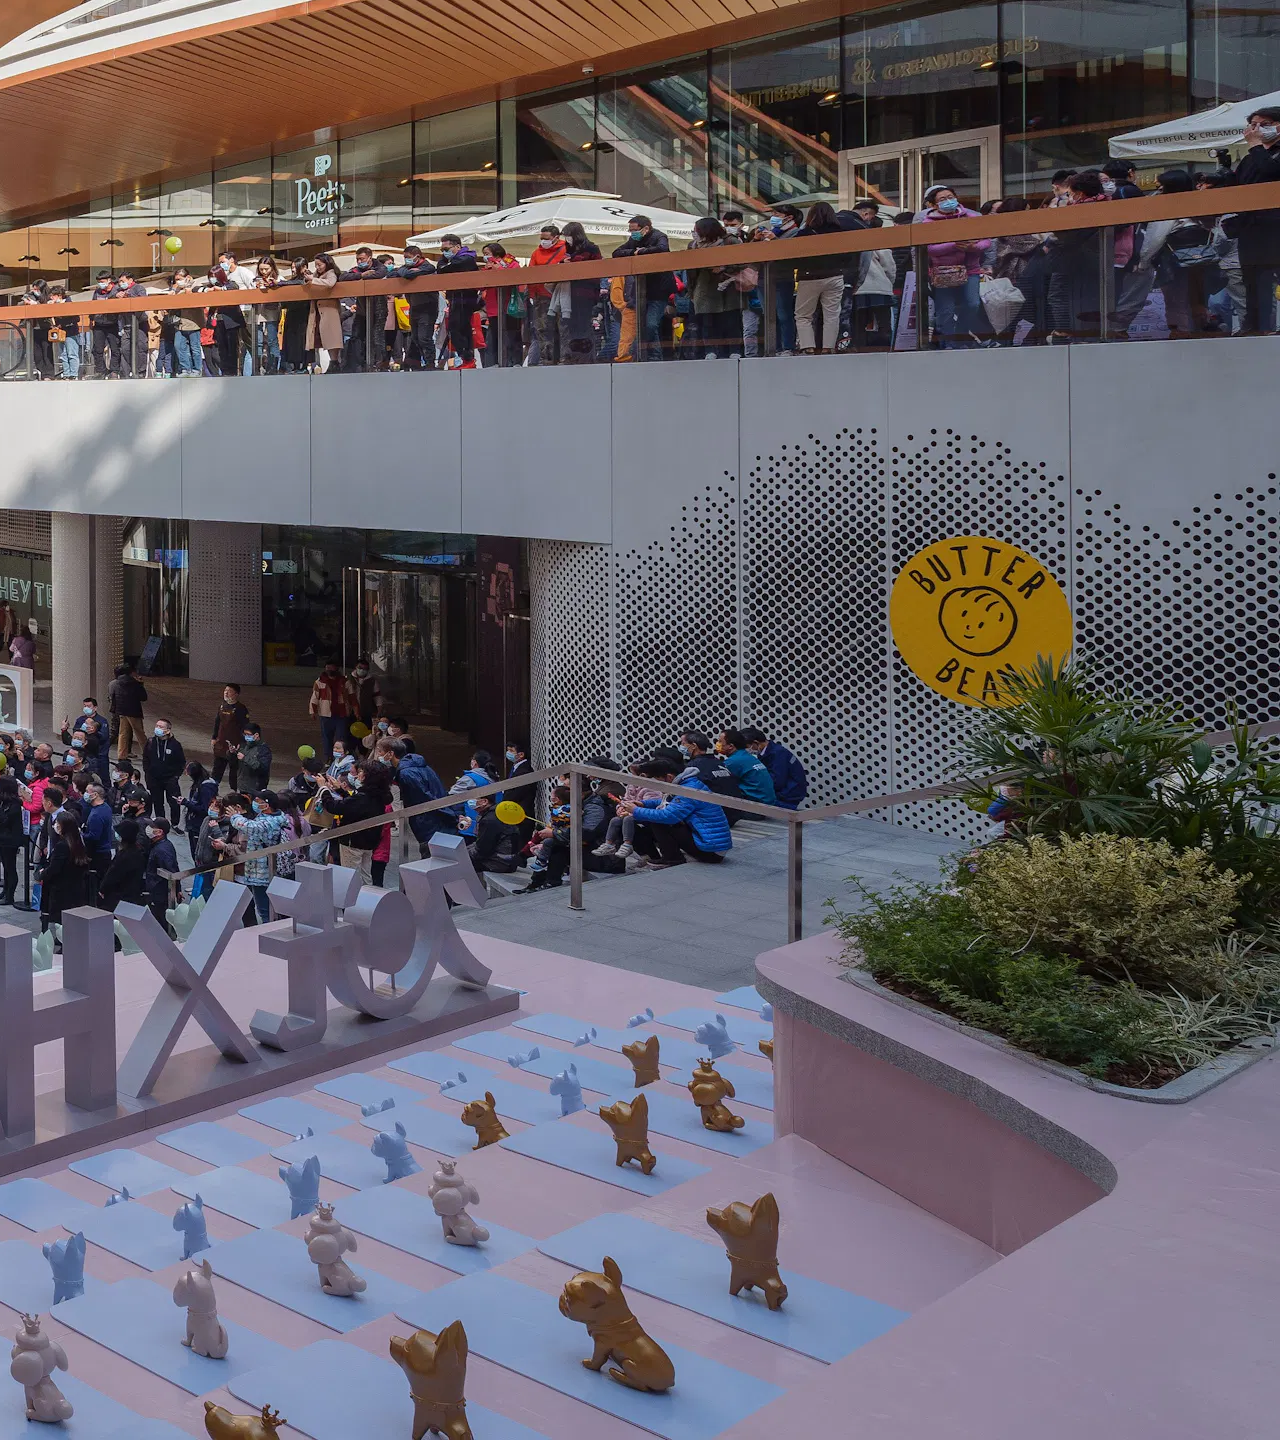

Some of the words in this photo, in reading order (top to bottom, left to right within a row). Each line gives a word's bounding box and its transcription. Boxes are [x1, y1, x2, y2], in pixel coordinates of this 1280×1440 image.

[1137, 134, 1185, 147] BUTTERFUL
[1188, 132, 1197, 141] &
[1200, 128, 1244, 139] CREAMOR
[304, 216, 335, 229] COFFEE
[908, 545, 1046, 600] BUTTER
